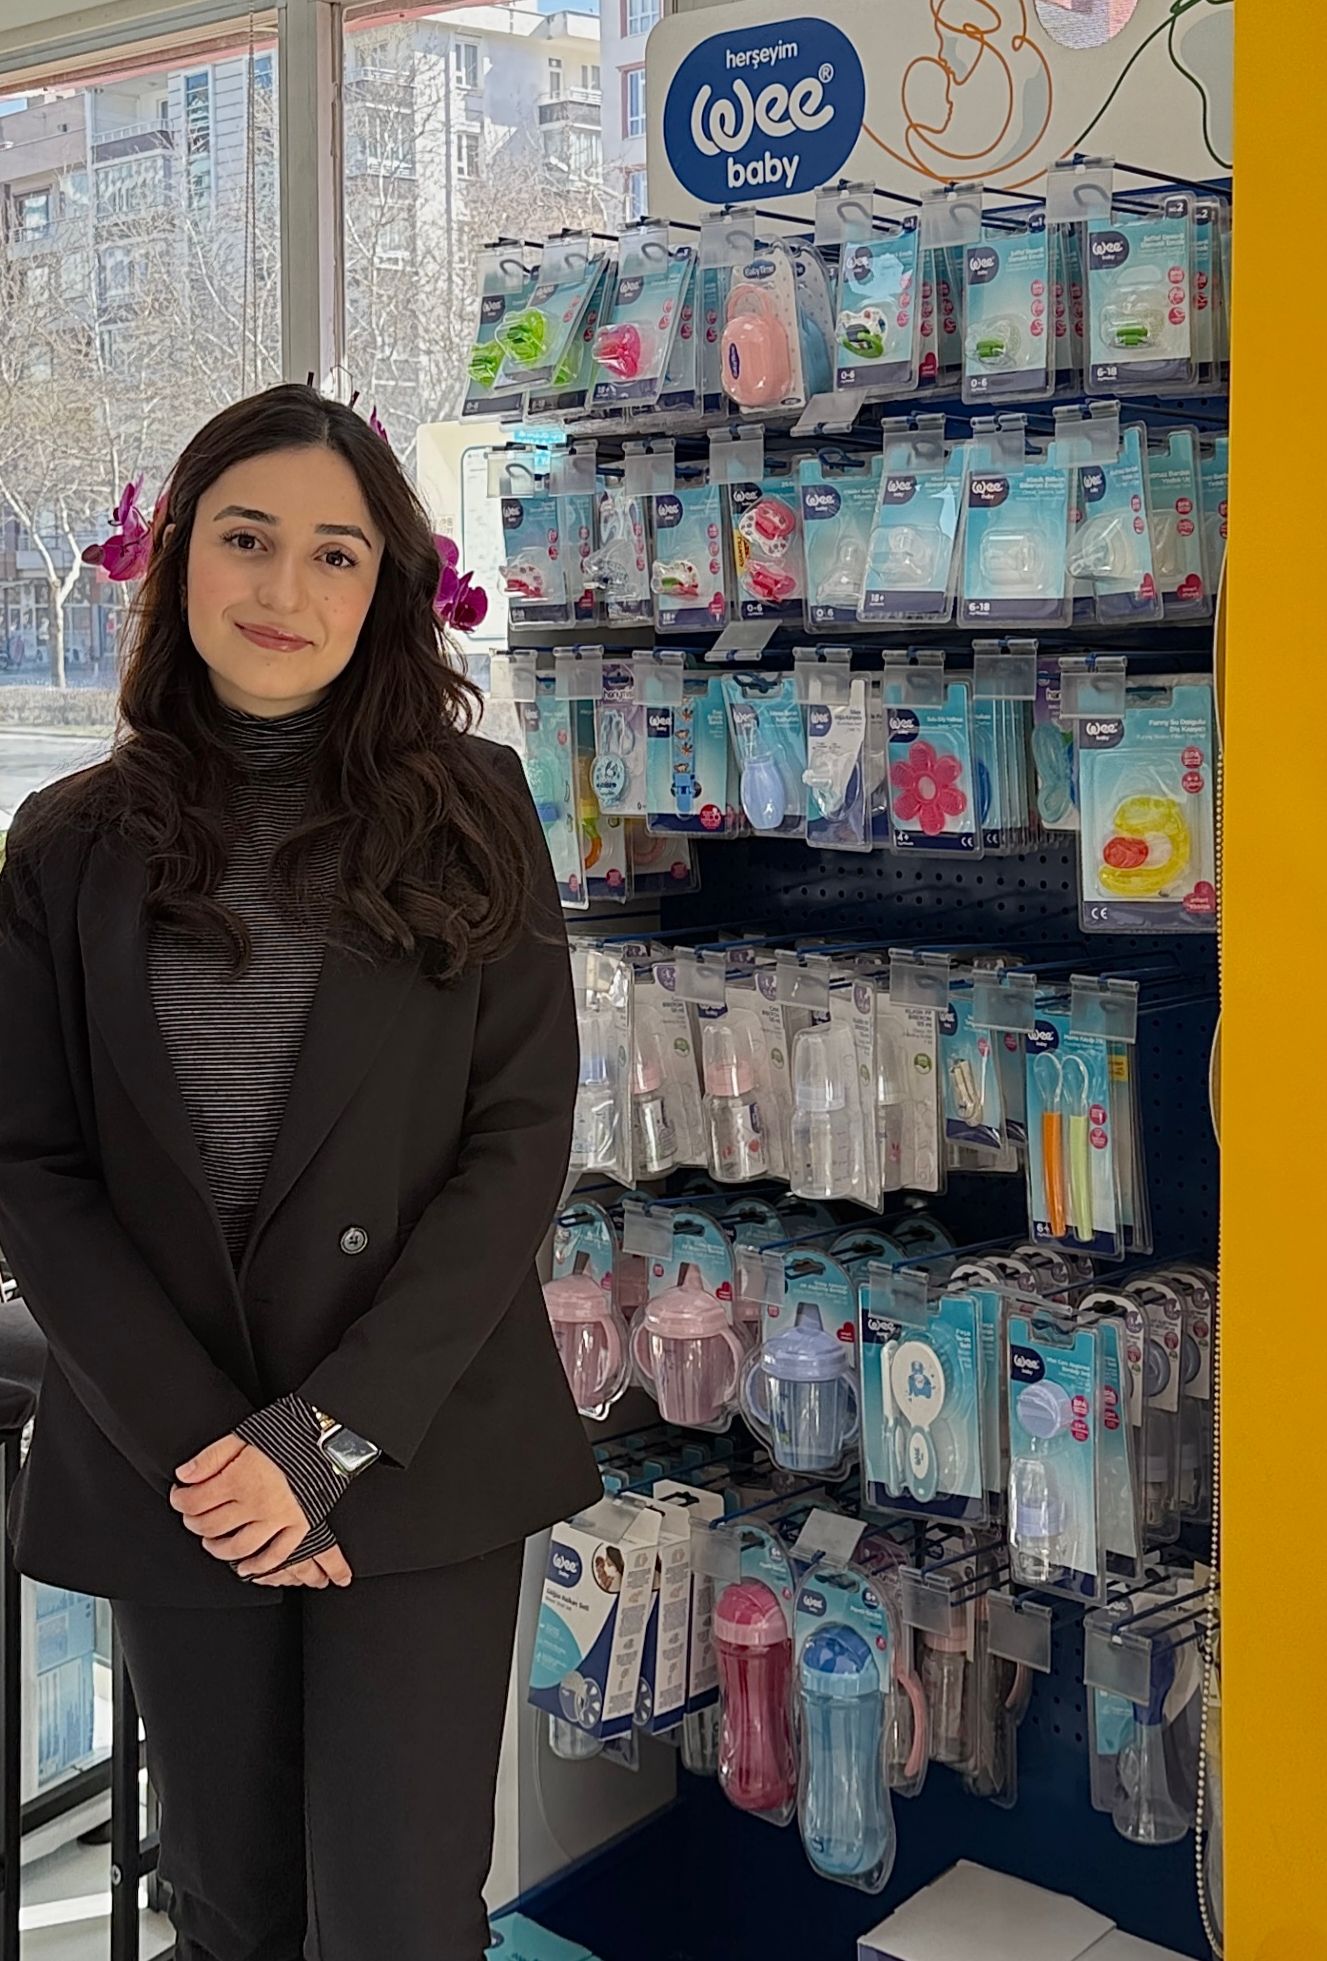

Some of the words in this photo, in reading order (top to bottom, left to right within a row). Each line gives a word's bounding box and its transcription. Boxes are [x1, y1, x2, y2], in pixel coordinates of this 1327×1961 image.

[726, 40, 798, 69] herşeyim
[727, 151, 800, 189] baby
[971, 379, 987, 387] 0-6
[969, 603, 990, 611] 6-18
[961, 837, 974, 847] CE
[1091, 908, 1108, 919] CE
